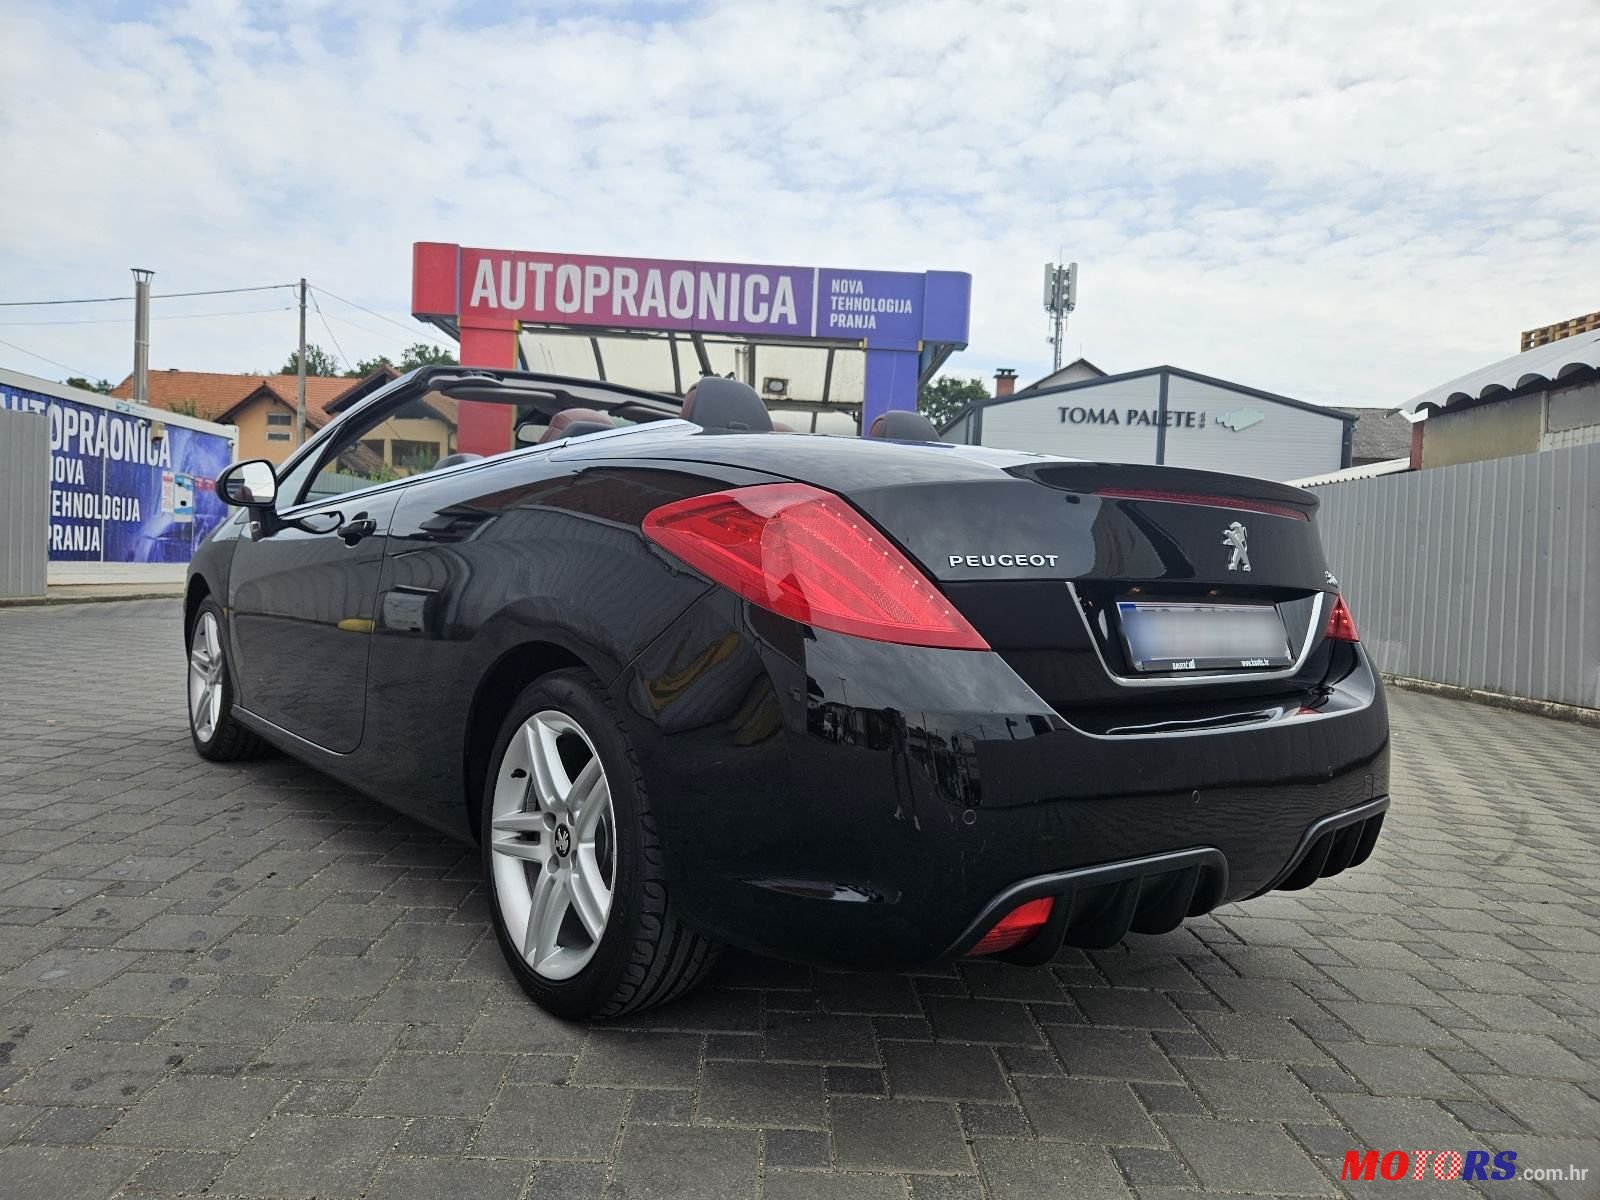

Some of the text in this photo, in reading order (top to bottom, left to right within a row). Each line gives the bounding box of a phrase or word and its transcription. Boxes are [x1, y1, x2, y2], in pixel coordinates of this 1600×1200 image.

[470, 258, 798, 325] AUTOPRAONICA
[831, 279, 864, 294] NOVA
[830, 296, 913, 314] TEHNOLOGIJA
[829, 313, 877, 330] PRANJA
[1058, 406, 1120, 425] TOMA
[1126, 409, 1196, 428] PALETE
[0, 392, 172, 468] OPRAONICA
[49, 489, 141, 522] EHNOLOGIJA
[948, 554, 1059, 567] PEUGEOT
